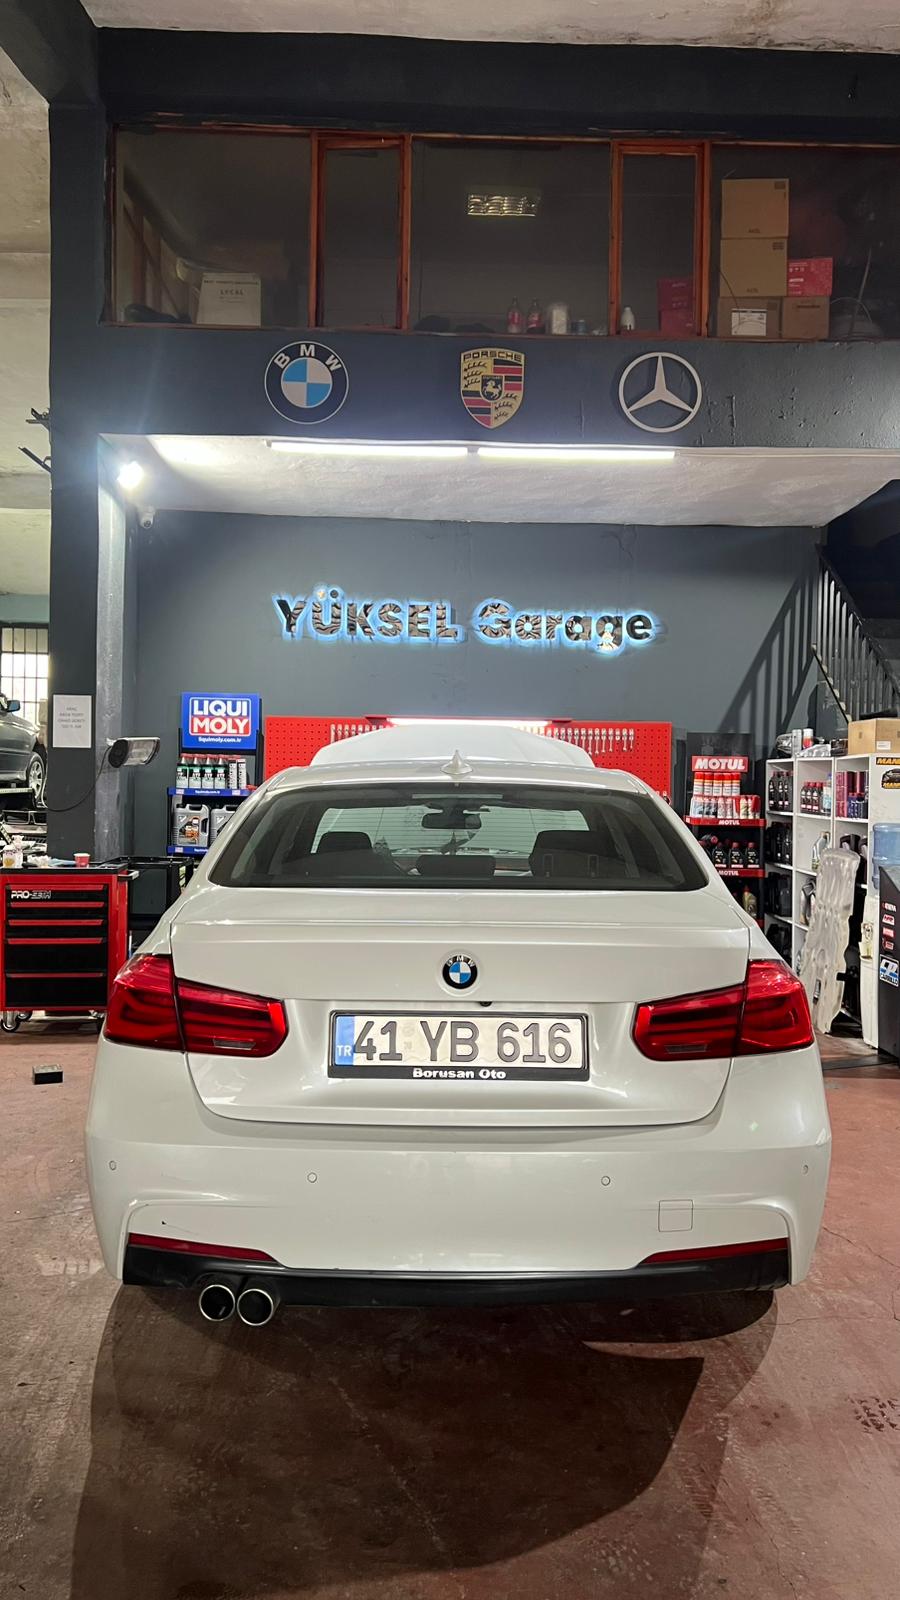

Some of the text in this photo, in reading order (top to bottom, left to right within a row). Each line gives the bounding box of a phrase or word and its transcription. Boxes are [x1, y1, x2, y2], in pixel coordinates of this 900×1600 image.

[274, 344, 341, 371] BMW
[463, 351, 522, 362] PORSCHE
[277, 589, 653, 651] YÜKSEL Garage
[193, 699, 248, 717] LIQUI
[192, 717, 249, 734] MOLY
[694, 758, 746, 770] MOTUL
[337, 1020, 573, 1064] TR 41 YB 616
[412, 1067, 507, 1080] Borusan Oto
